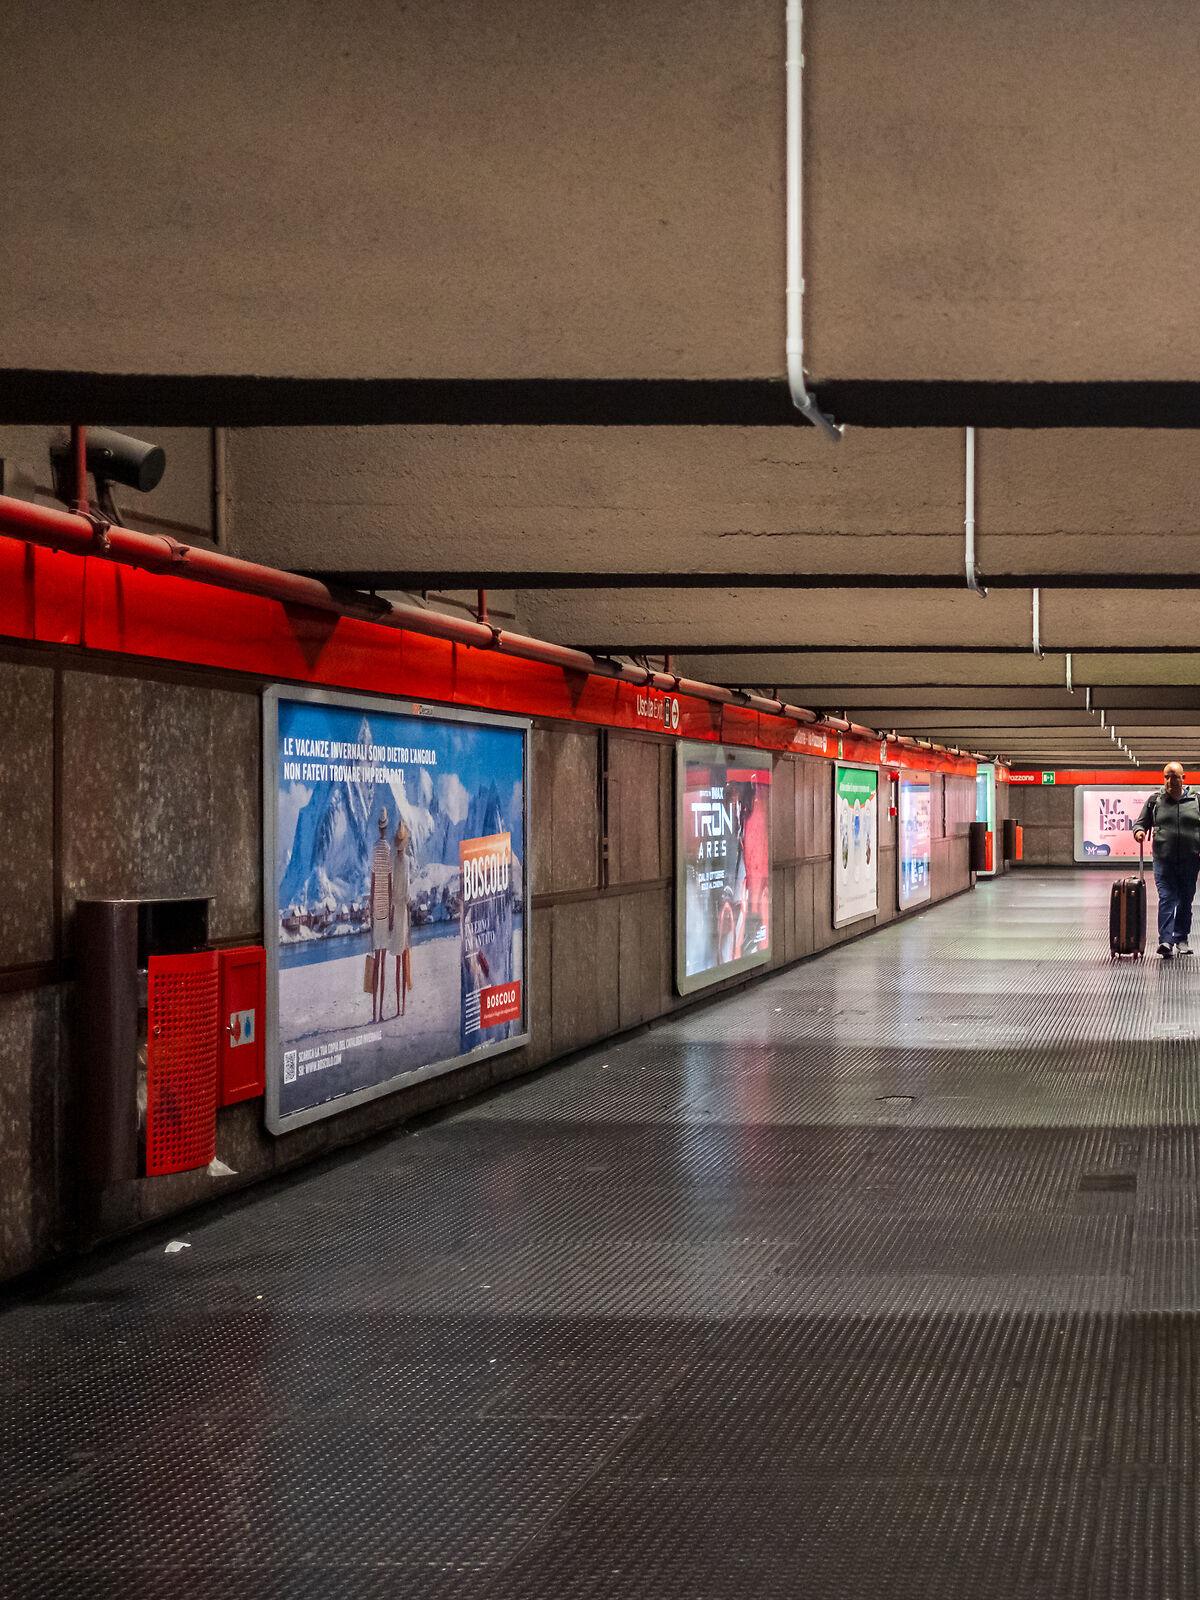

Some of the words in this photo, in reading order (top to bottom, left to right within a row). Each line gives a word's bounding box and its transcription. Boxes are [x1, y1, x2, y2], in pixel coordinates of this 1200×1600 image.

[284, 738, 294, 756] LE
[295, 739, 329, 758] VACANZE
[331, 741, 368, 760] INVERNALI
[369, 745, 386, 762] SONO
[387, 746, 409, 764] DIETRO
[410, 748, 438, 765] L'ANGOLO.
[284, 762, 301, 780] NON
[302, 764, 328, 781] FATEVI
[330, 765, 361, 783] TROVARE
[362, 767, 406, 785] IMPREPARATI.
[1009, 774, 1034, 782] ozzone
[1099, 798, 1125, 815] M.C.
[691, 802, 733, 838] TRON
[698, 840, 727, 859] ARES
[463, 851, 509, 902] BOSCOLO
[486, 990, 516, 1009] BOSCOLO
